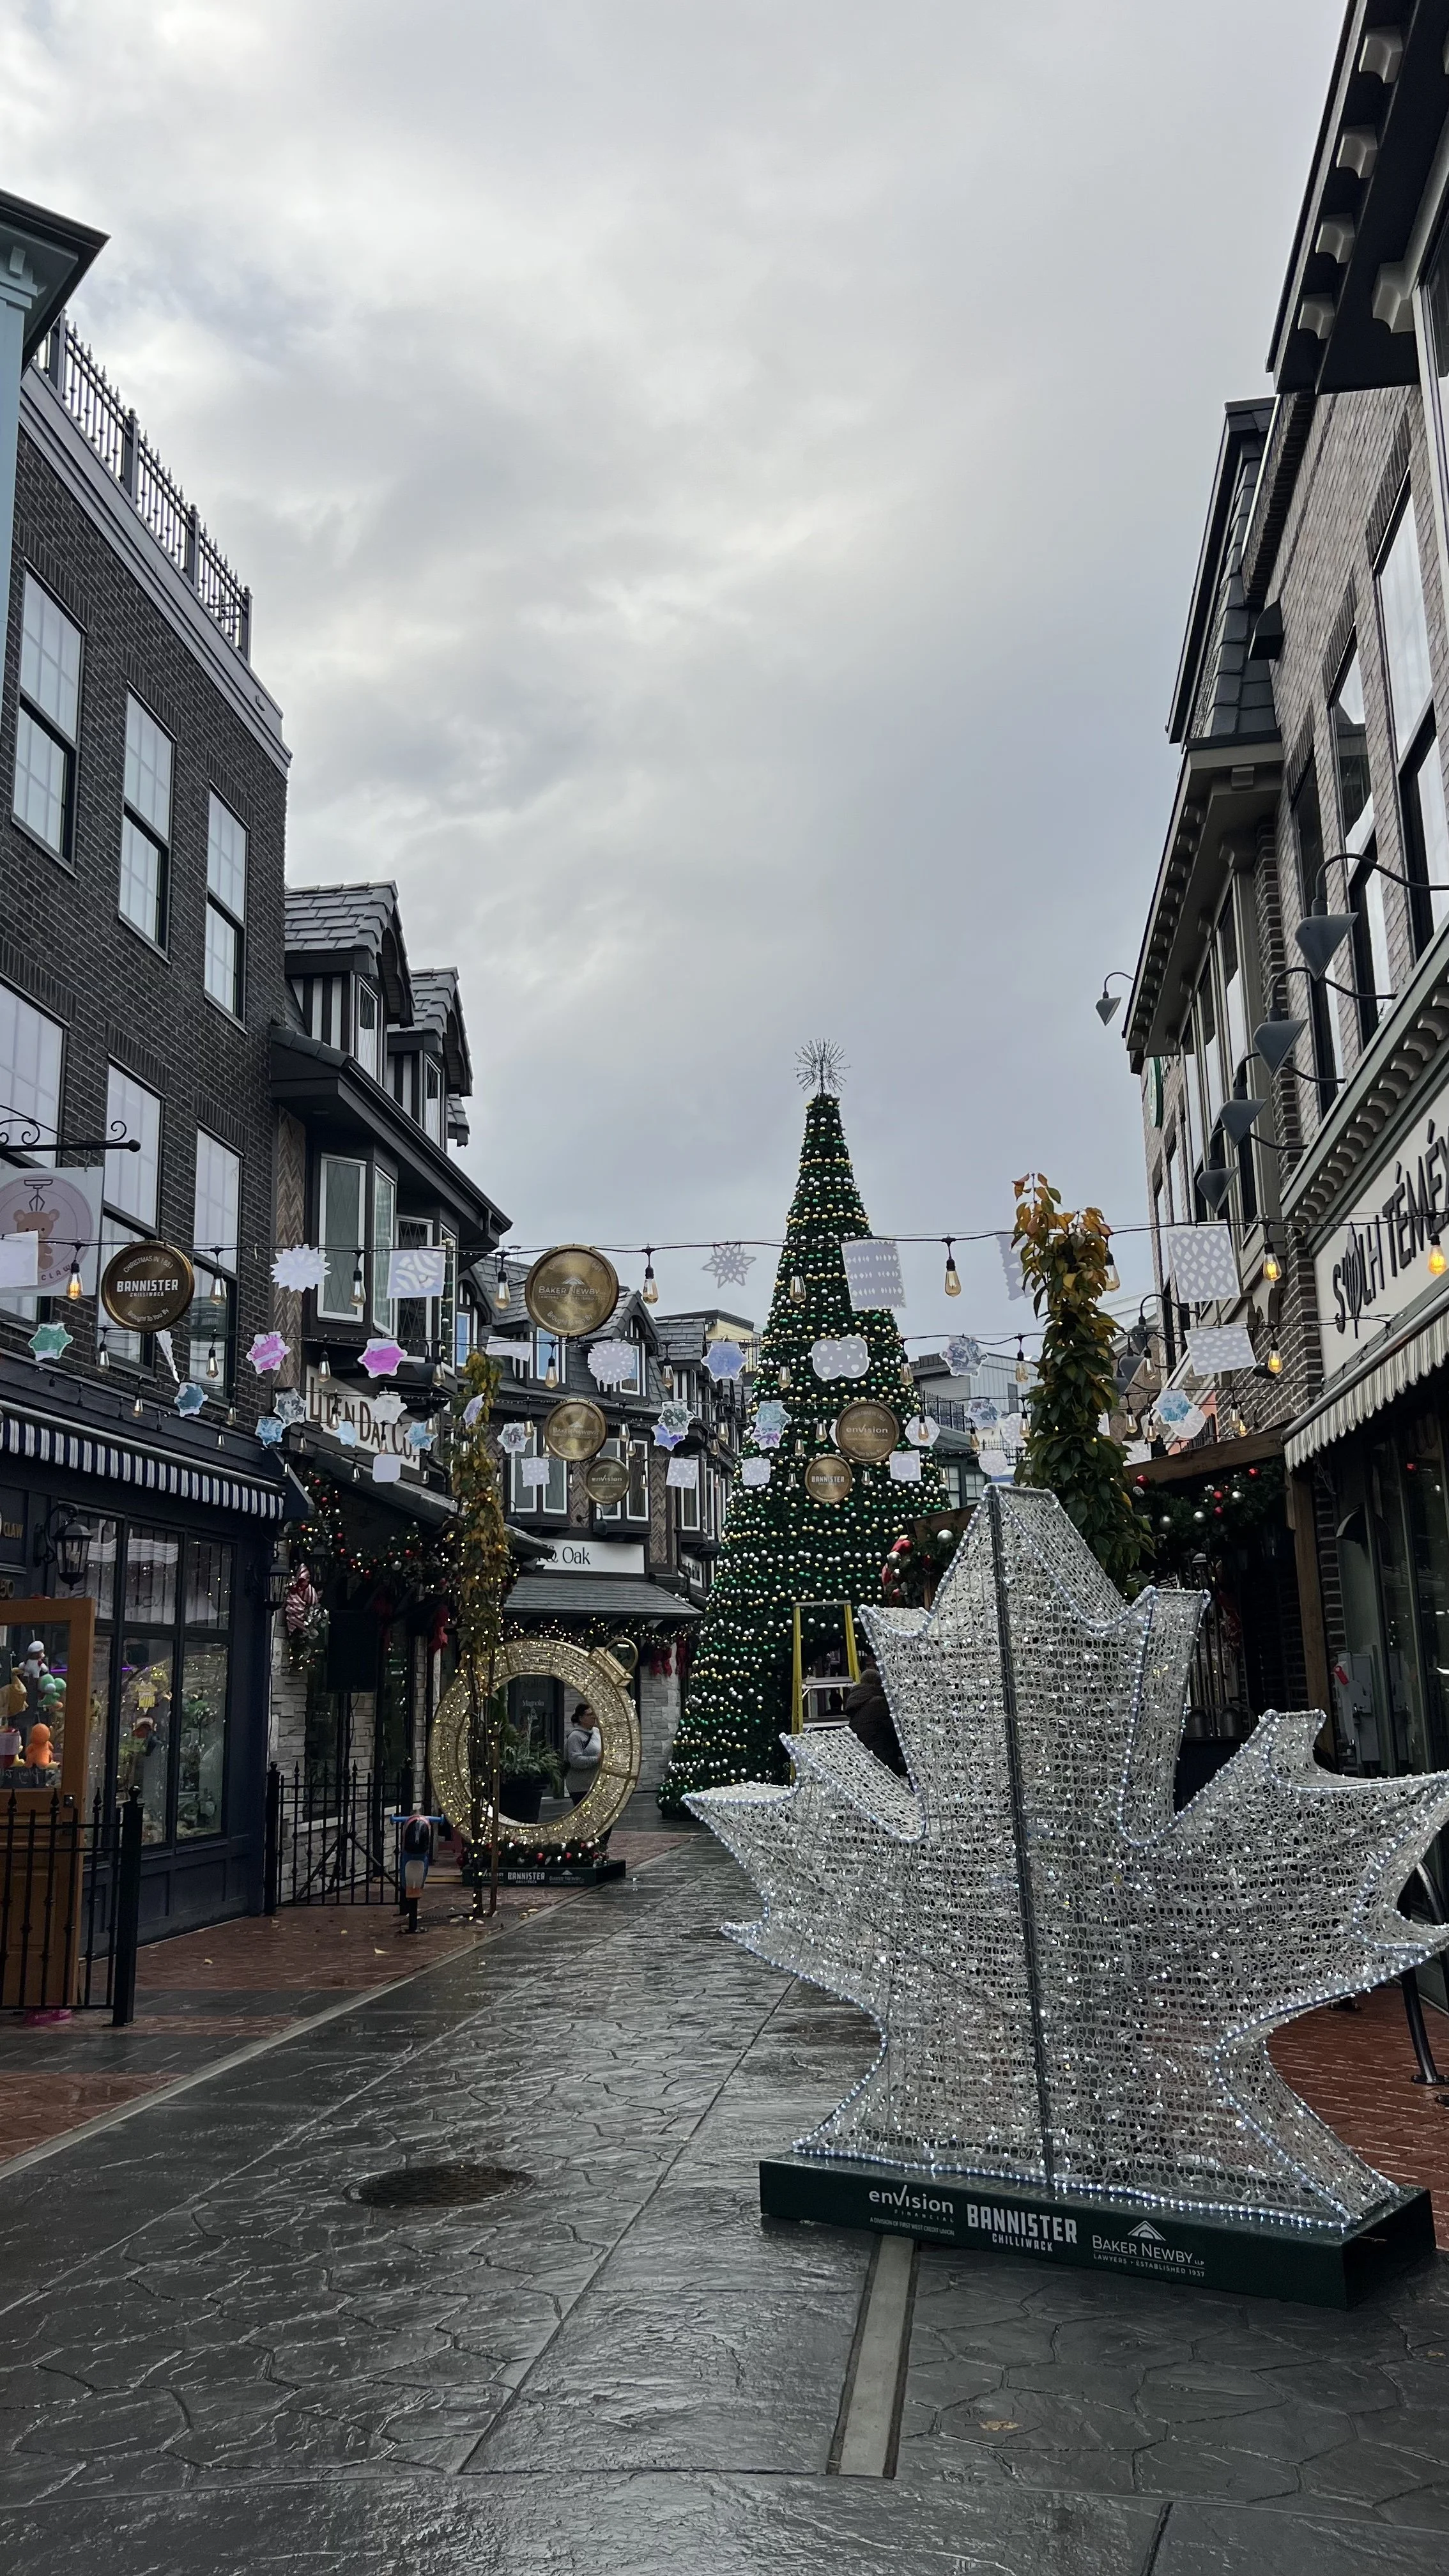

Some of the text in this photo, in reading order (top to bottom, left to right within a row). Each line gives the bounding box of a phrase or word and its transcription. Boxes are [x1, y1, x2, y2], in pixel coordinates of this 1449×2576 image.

[41, 1264, 72, 1281] CLAW
[123, 1255, 153, 1273] CHRISTMAS
[160, 1257, 173, 1269] 1881
[116, 1279, 179, 1292] BANNISTER
[538, 1285, 599, 1295] BAKER NEWBY
[562, 1545, 591, 1565] Oak
[507, 1871, 545, 1880] BANNISTER
[894, 2209, 954, 2223] FINANCIAL
[967, 2204, 1078, 2244] BANNISTER
[874, 2217, 893, 2225] DIVISION
[923, 2225, 939, 2233] CREDIT
[939, 2227, 954, 2235] UNION
[992, 2233, 1053, 2252] CHILLIWACK
[1092, 2234, 1137, 2255] BAKER
[1142, 2242, 1193, 2264] NEWBY
[1093, 2253, 1205, 2278] LAWYERS ESTABLISHED 1937
